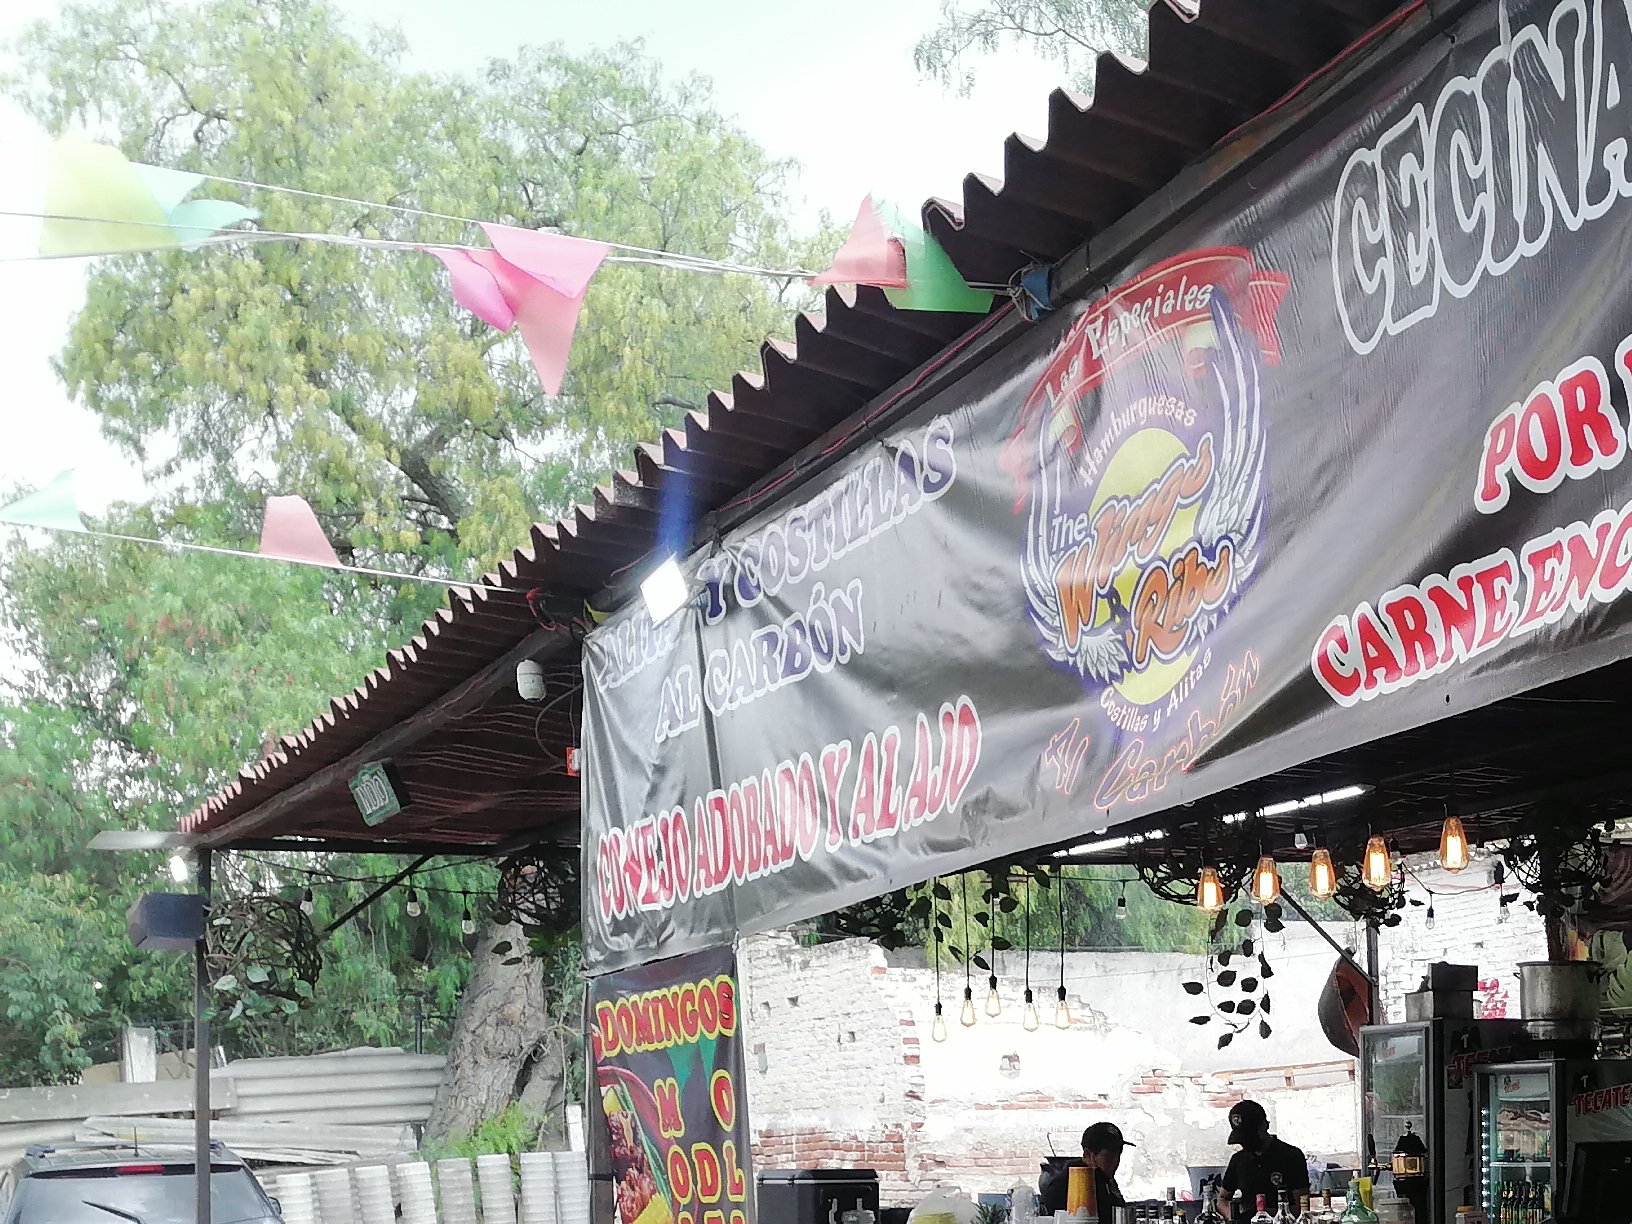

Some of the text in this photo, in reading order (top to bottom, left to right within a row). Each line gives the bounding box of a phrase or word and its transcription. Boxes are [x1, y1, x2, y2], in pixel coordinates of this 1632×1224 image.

[1046, 274, 1214, 409] Las Especiales
[1079, 394, 1198, 486] Hamburguesas
[1478, 358, 1622, 512] POR
[697, 557, 730, 626] Y
[734, 415, 957, 608] COSTILLAS
[1052, 512, 1088, 550] The
[1055, 432, 1214, 655] Wings
[655, 578, 864, 743] AL CARBÓN
[1131, 537, 1236, 668] Ribs
[1312, 548, 1520, 707] CARNE
[1045, 716, 1090, 794] Al
[1100, 685, 1147, 731] Costillas
[1166, 648, 1212, 717] Alitas
[597, 694, 982, 924] CONEJO ADOBADO Y AL AJO
[596, 975, 736, 1057] DOMINGOS
